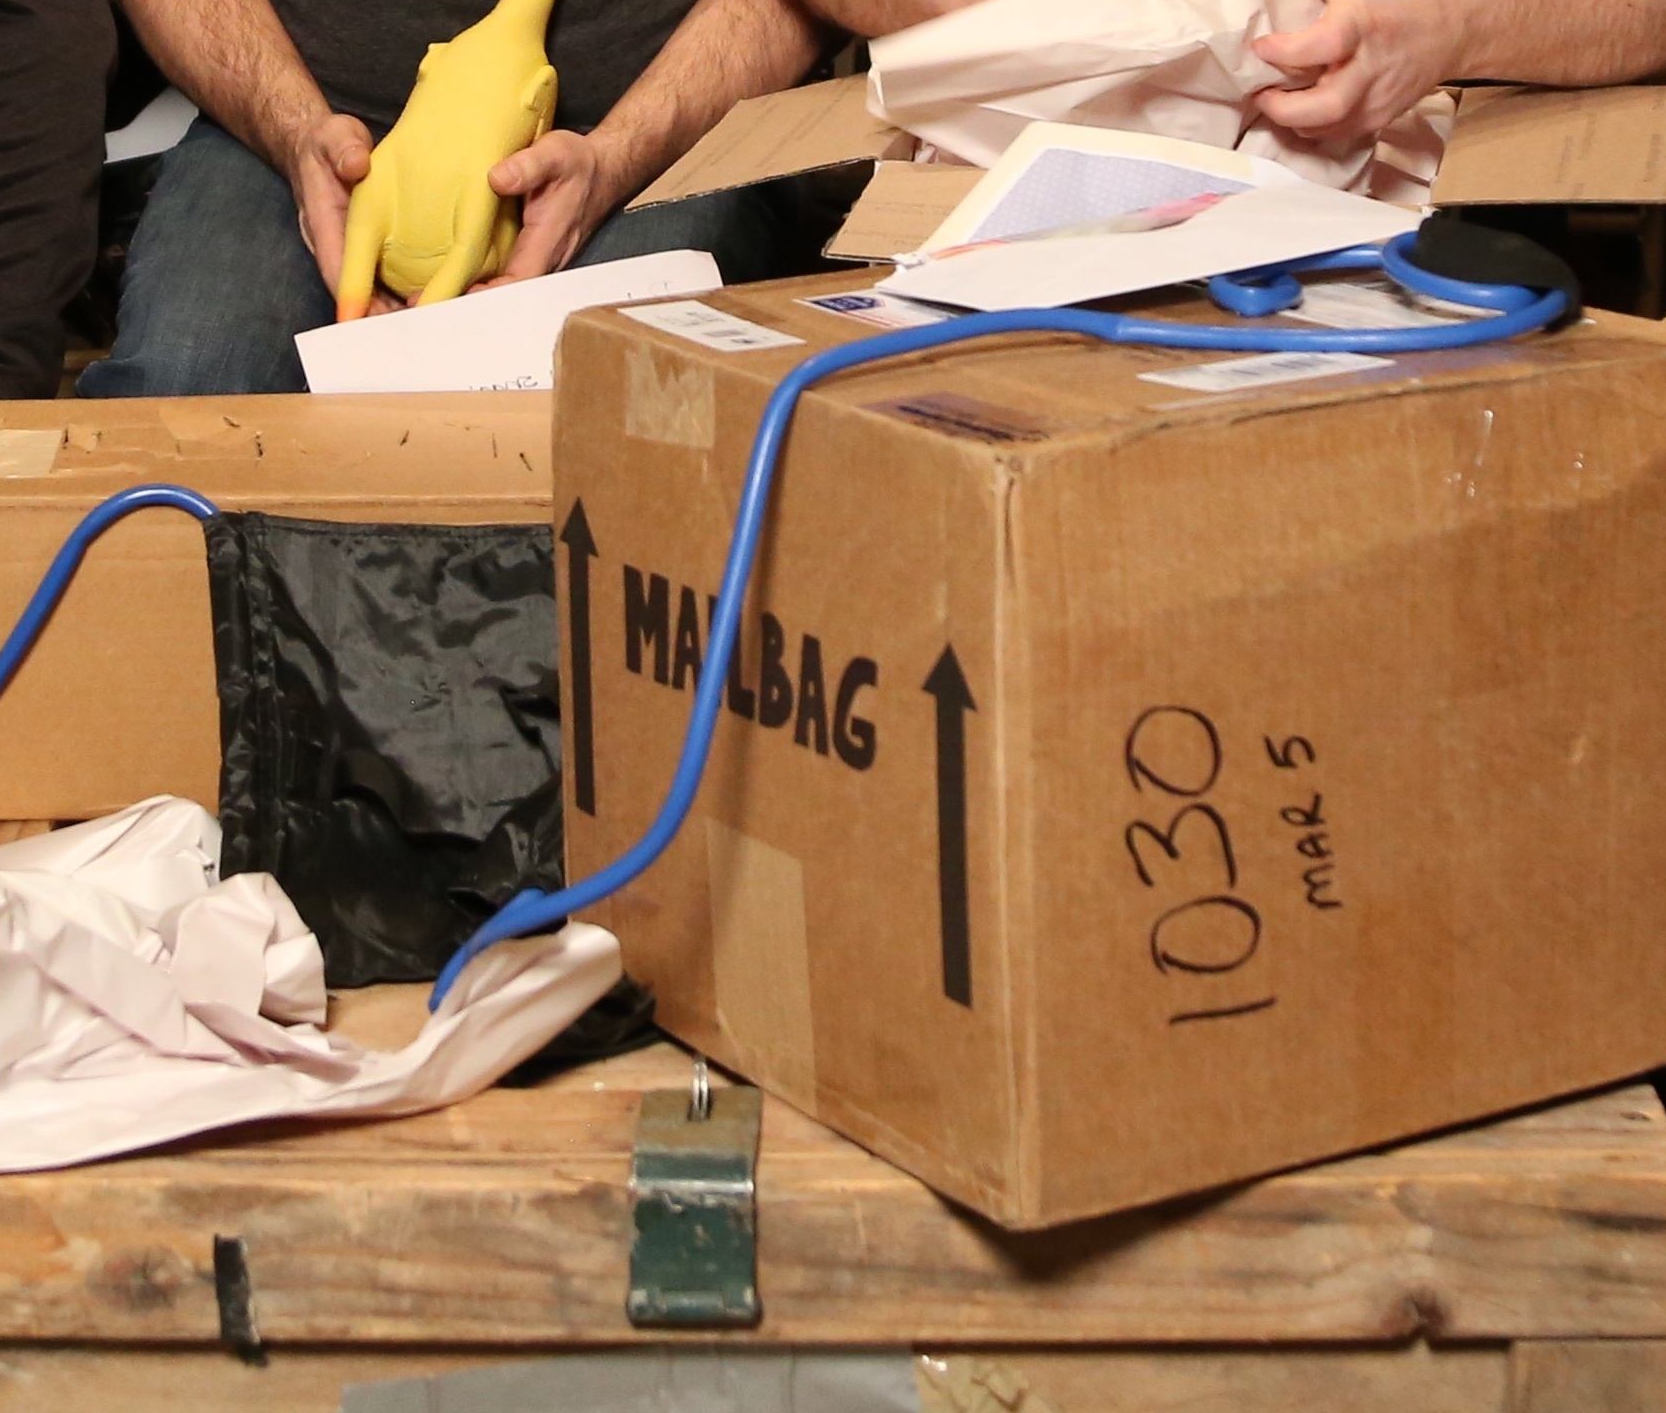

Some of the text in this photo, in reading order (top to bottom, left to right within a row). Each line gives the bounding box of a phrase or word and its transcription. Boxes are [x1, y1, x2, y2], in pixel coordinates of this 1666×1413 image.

[622, 563, 879, 773] MALBAG
[1125, 704, 1277, 1025] 1030
[1264, 732, 1343, 911] MAR 5
